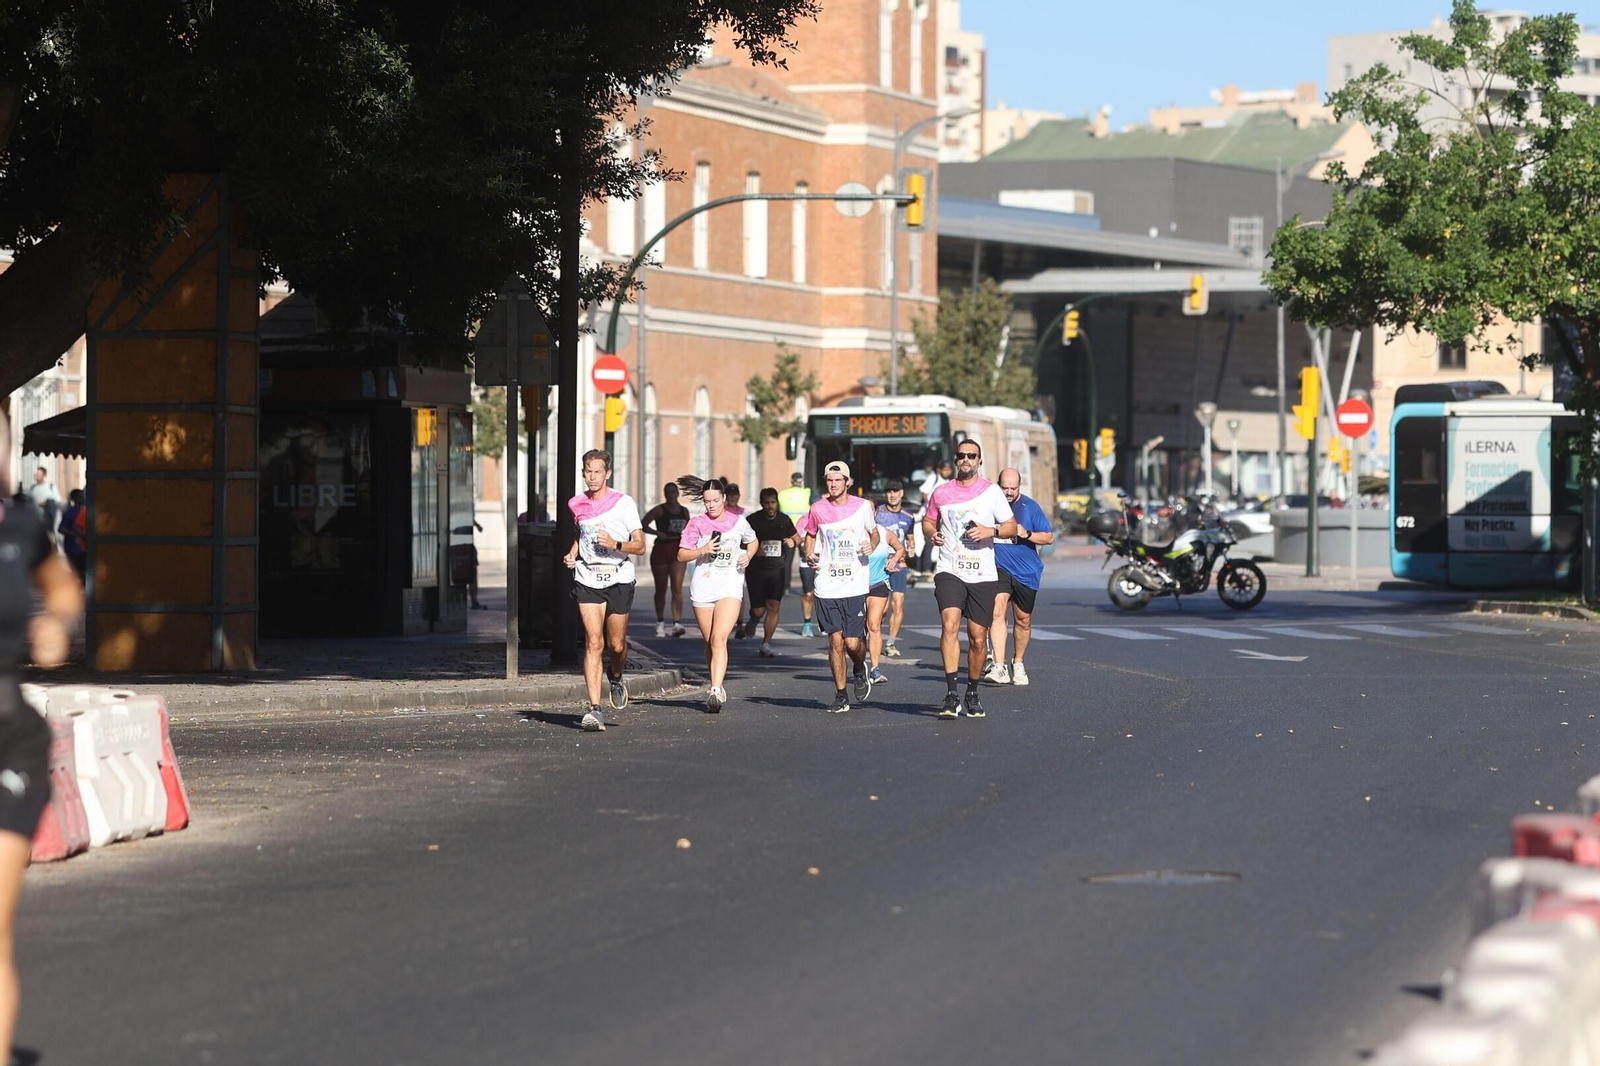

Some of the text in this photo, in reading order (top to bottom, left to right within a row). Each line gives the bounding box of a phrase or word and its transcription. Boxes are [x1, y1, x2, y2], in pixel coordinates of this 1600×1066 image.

[849, 416, 899, 434] PARQUE
[902, 416, 927, 433] SUR
[272, 484, 357, 508] LIBRE
[1396, 516, 1416, 528] 672
[958, 561, 980, 570] 530
[596, 573, 611, 582] 52
[830, 567, 852, 578] 395
